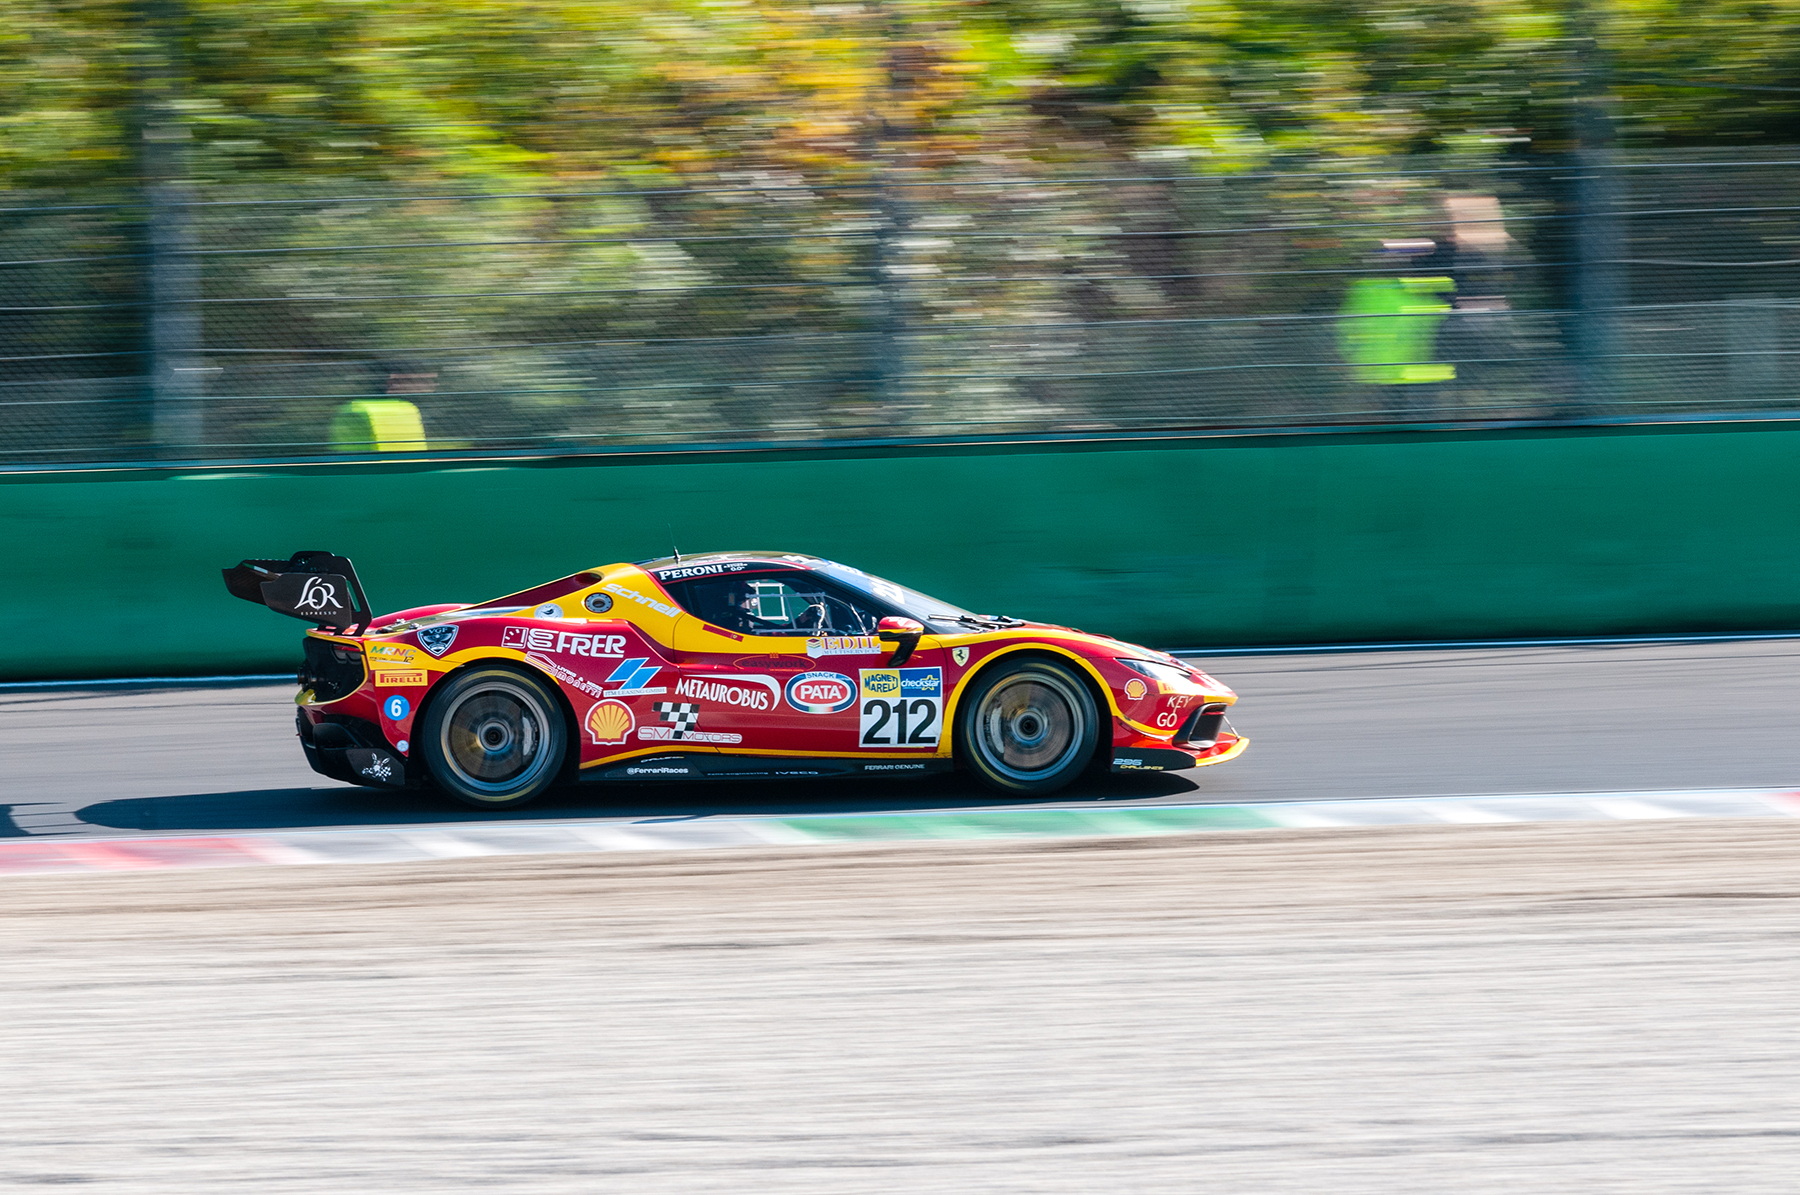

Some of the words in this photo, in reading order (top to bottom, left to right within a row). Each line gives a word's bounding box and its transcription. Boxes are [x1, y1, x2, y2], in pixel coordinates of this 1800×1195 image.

[659, 564, 724, 580] PERONI
[823, 636, 881, 650] EDIL
[742, 658, 807, 669] easywork
[379, 672, 423, 684] PIRELLI
[806, 671, 836, 679] SNACK
[674, 678, 769, 711] METAUROBUS
[800, 684, 842, 700] PATA
[390, 699, 402, 717] 6
[1166, 695, 1194, 708] KEY
[862, 699, 937, 745] 212
[1156, 712, 1178, 728] GO
[639, 727, 671, 740] SM
[682, 730, 741, 743] MOTORS
[626, 767, 689, 775] @FerrariRaces
